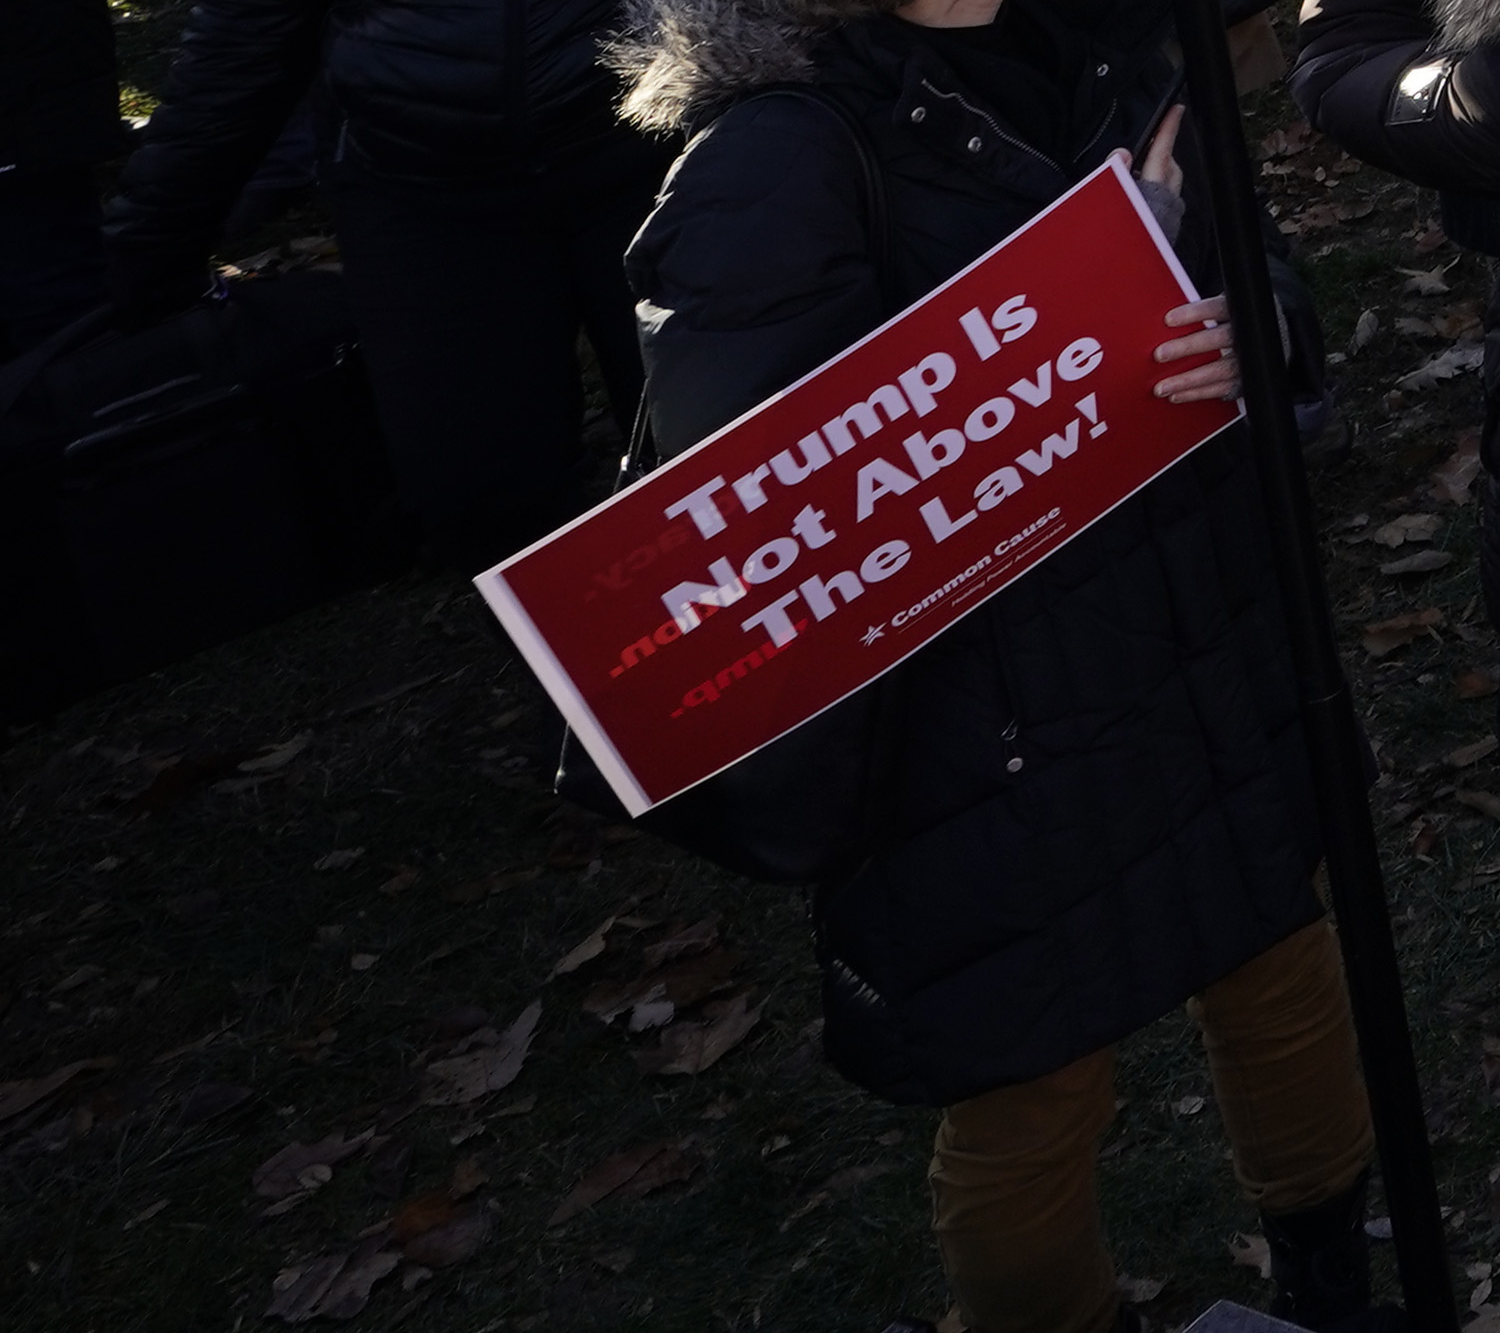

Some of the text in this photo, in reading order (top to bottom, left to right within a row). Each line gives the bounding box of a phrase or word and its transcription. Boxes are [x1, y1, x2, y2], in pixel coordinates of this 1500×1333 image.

[661, 502, 837, 635] Not
[856, 336, 1105, 523] Above
[664, 293, 1038, 541] Trump Is
[741, 538, 913, 649] The
[919, 392, 1109, 545] Law!
[891, 507, 1061, 627] Common Cause
